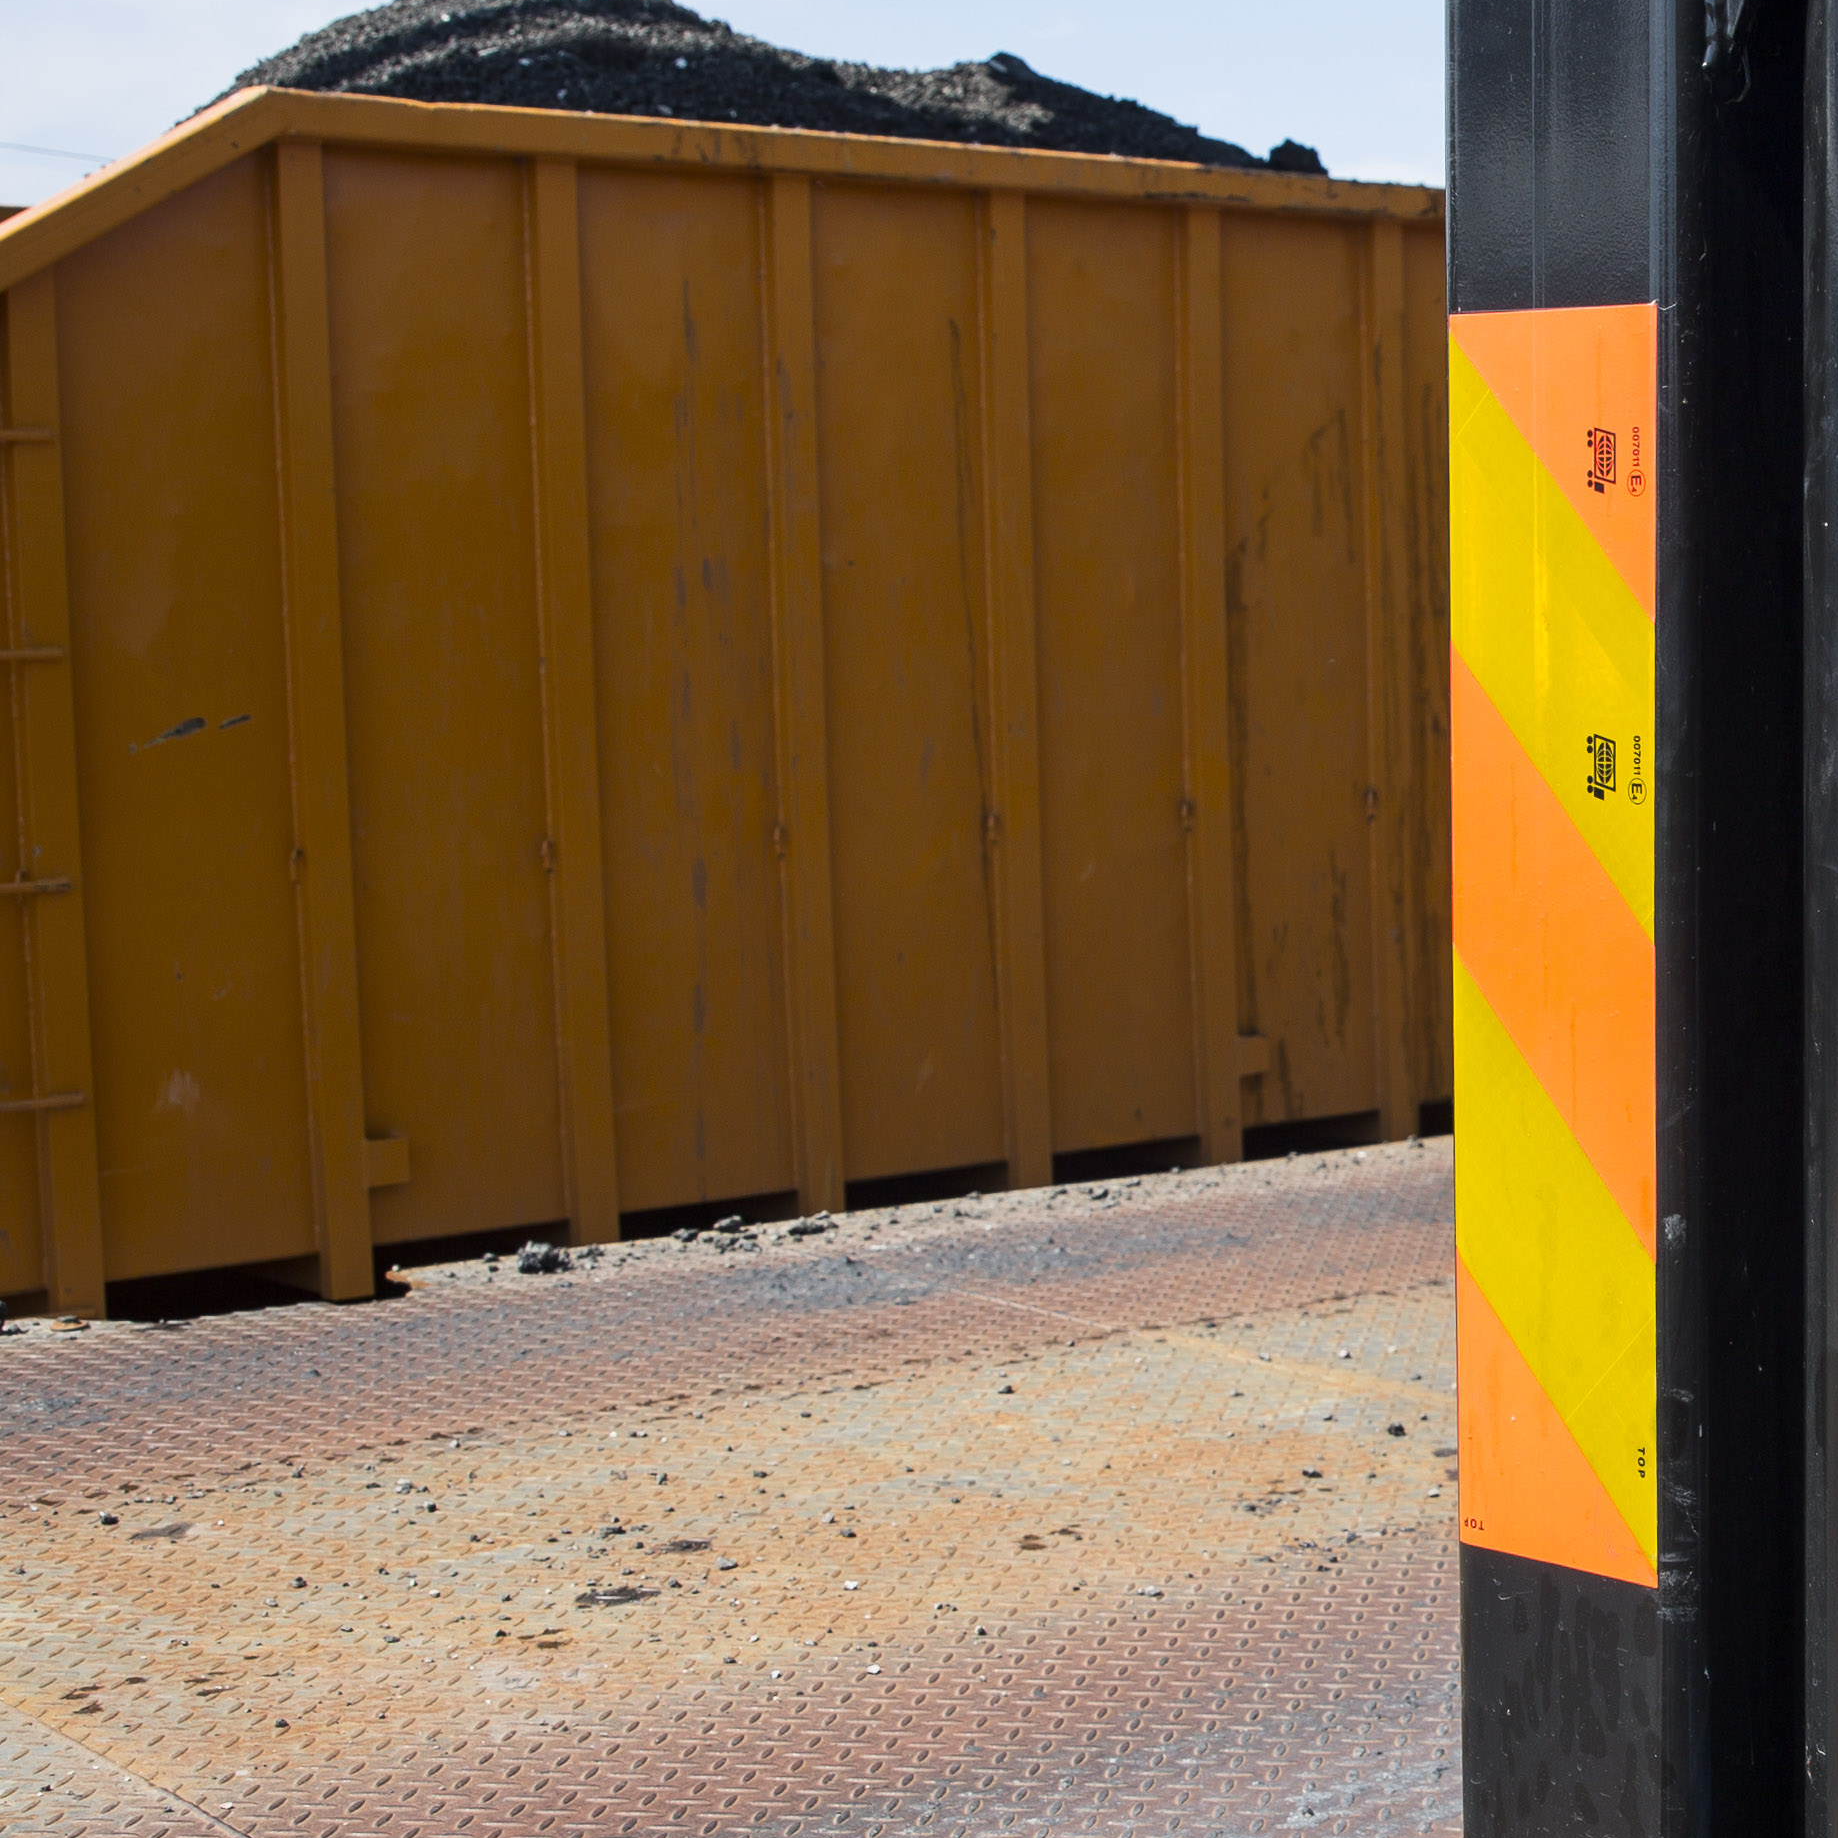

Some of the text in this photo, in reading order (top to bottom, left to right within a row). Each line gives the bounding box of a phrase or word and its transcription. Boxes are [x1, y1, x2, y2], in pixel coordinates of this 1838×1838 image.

[1631, 426, 1641, 468] 007011
[1632, 735, 1642, 777] 007011
[1637, 1446, 1646, 1479] TOP
[1464, 1517, 1485, 1531] TOP
